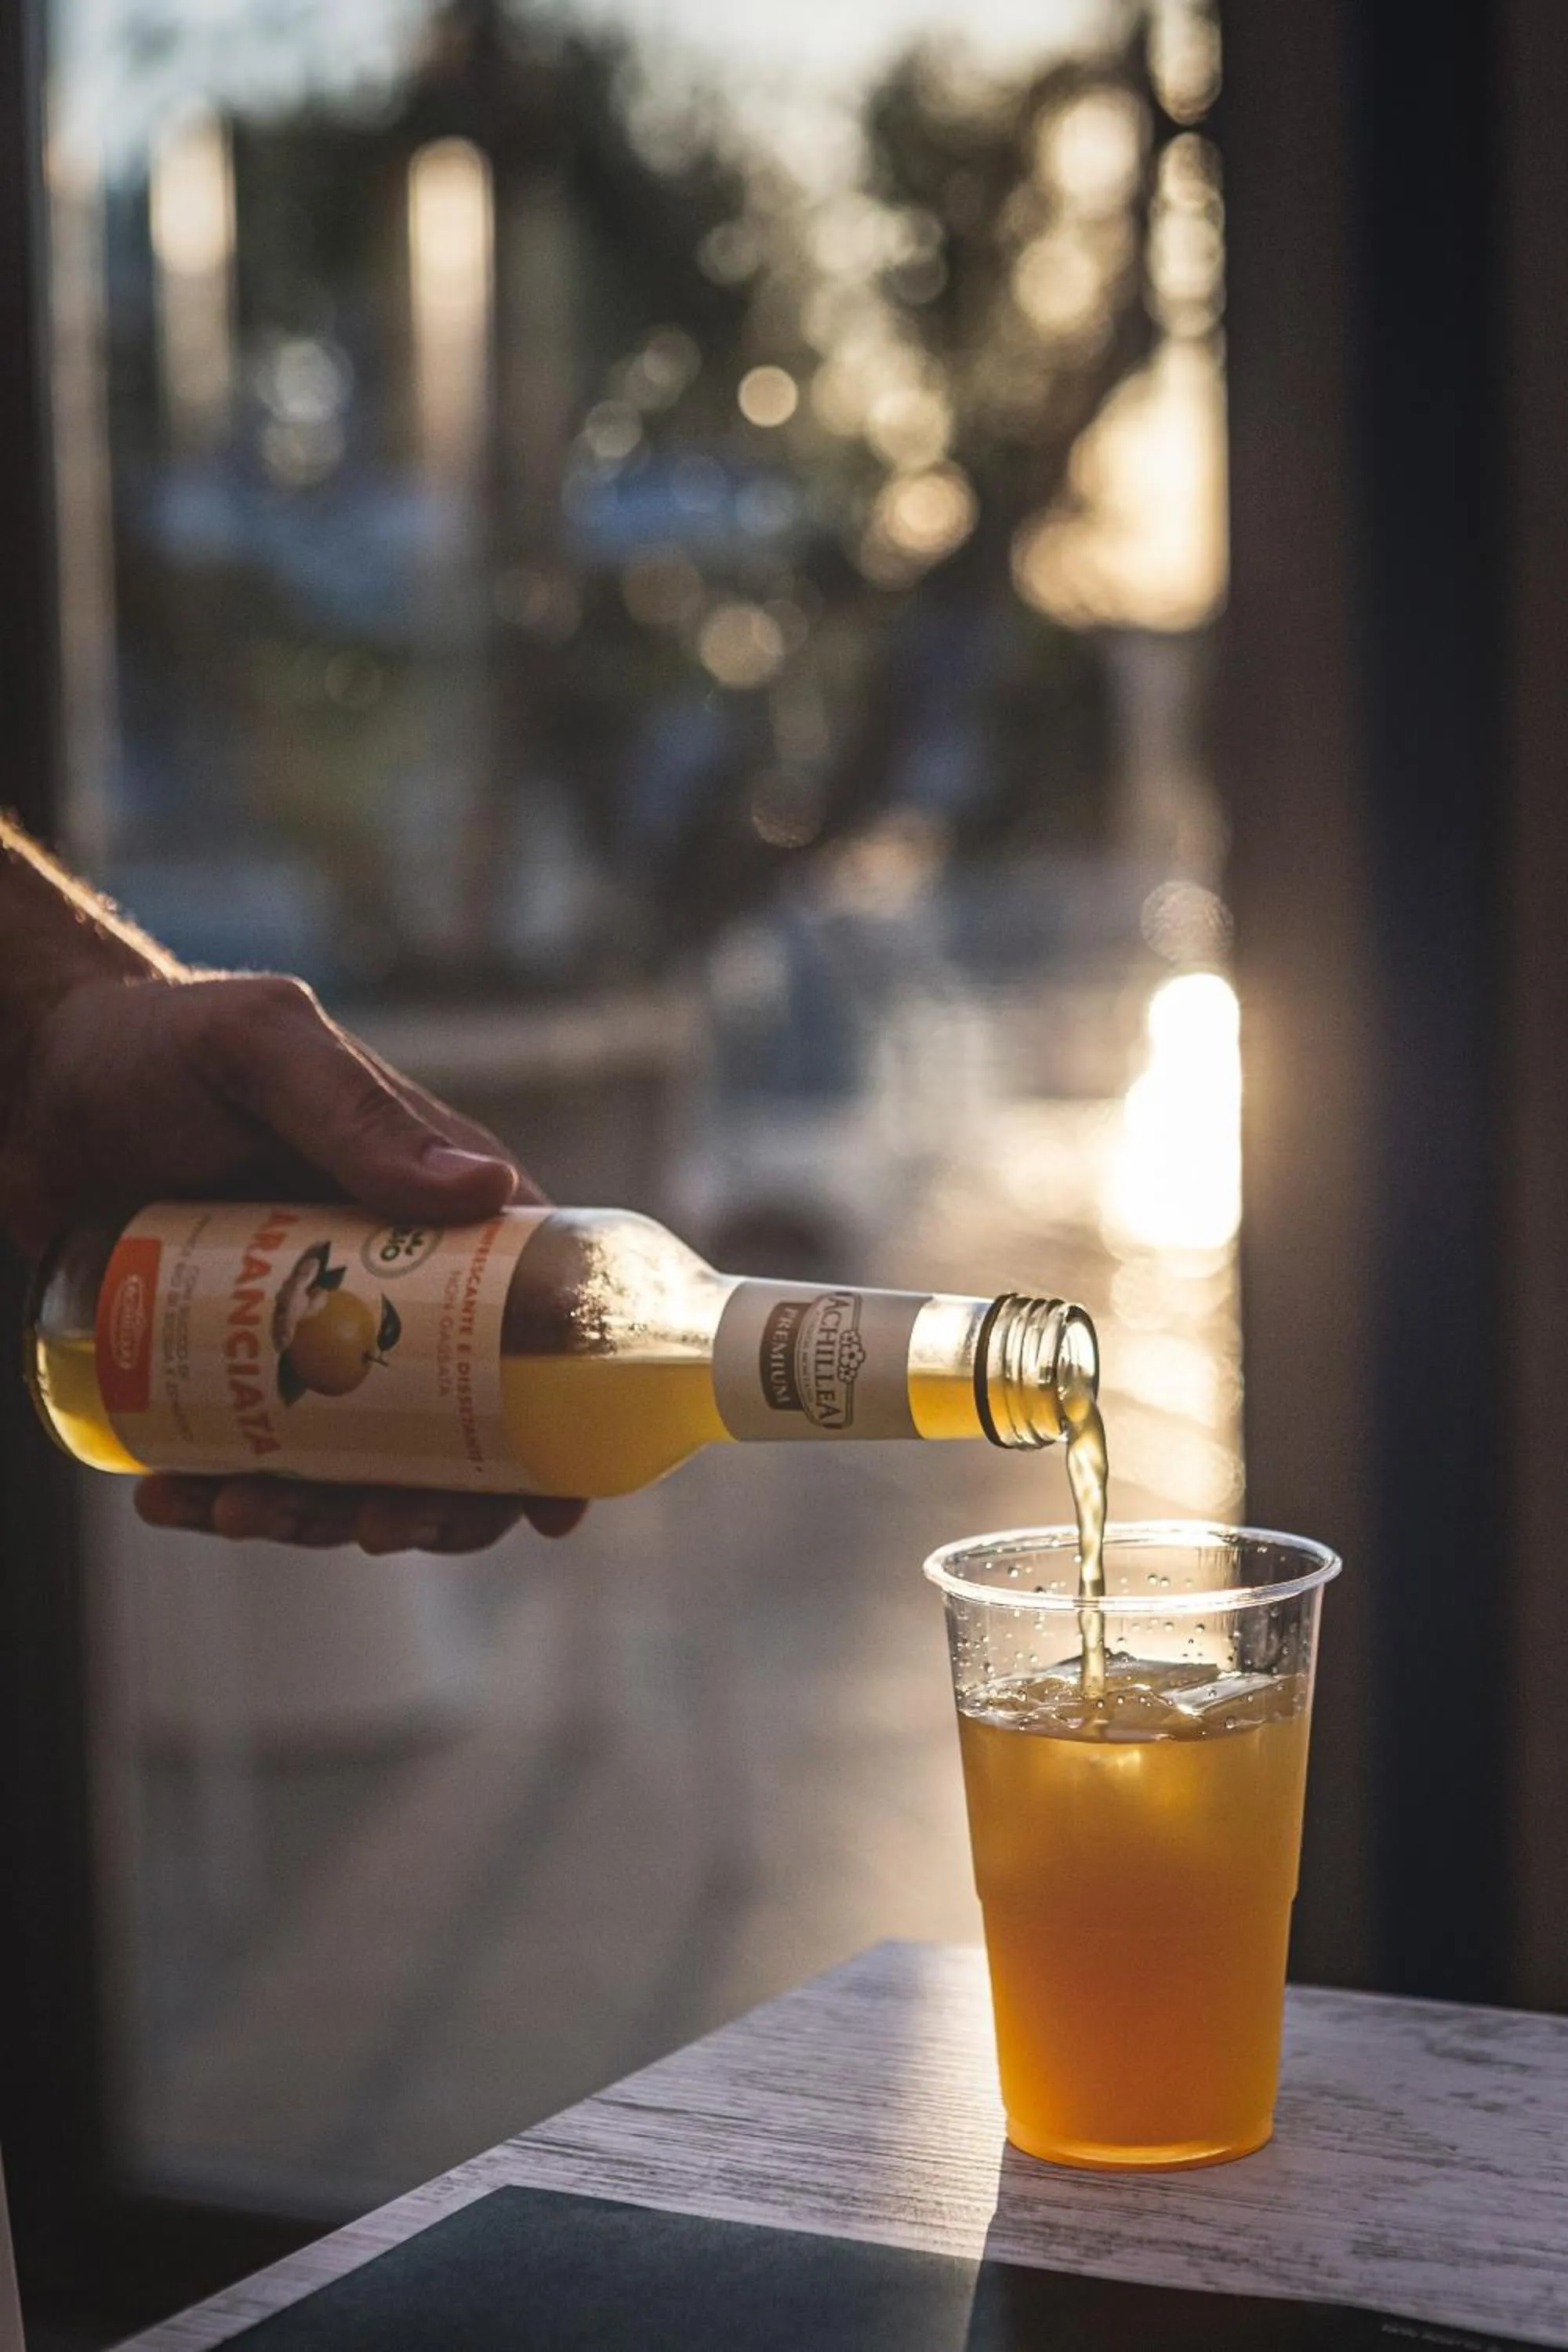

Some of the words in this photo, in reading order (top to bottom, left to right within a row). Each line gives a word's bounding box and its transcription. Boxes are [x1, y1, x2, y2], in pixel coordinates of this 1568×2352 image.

[226, 1210, 298, 1455] ARANCIATA
[769, 1307, 799, 1403] PREMIUM
[815, 1297, 850, 1421] ACHILLEA
